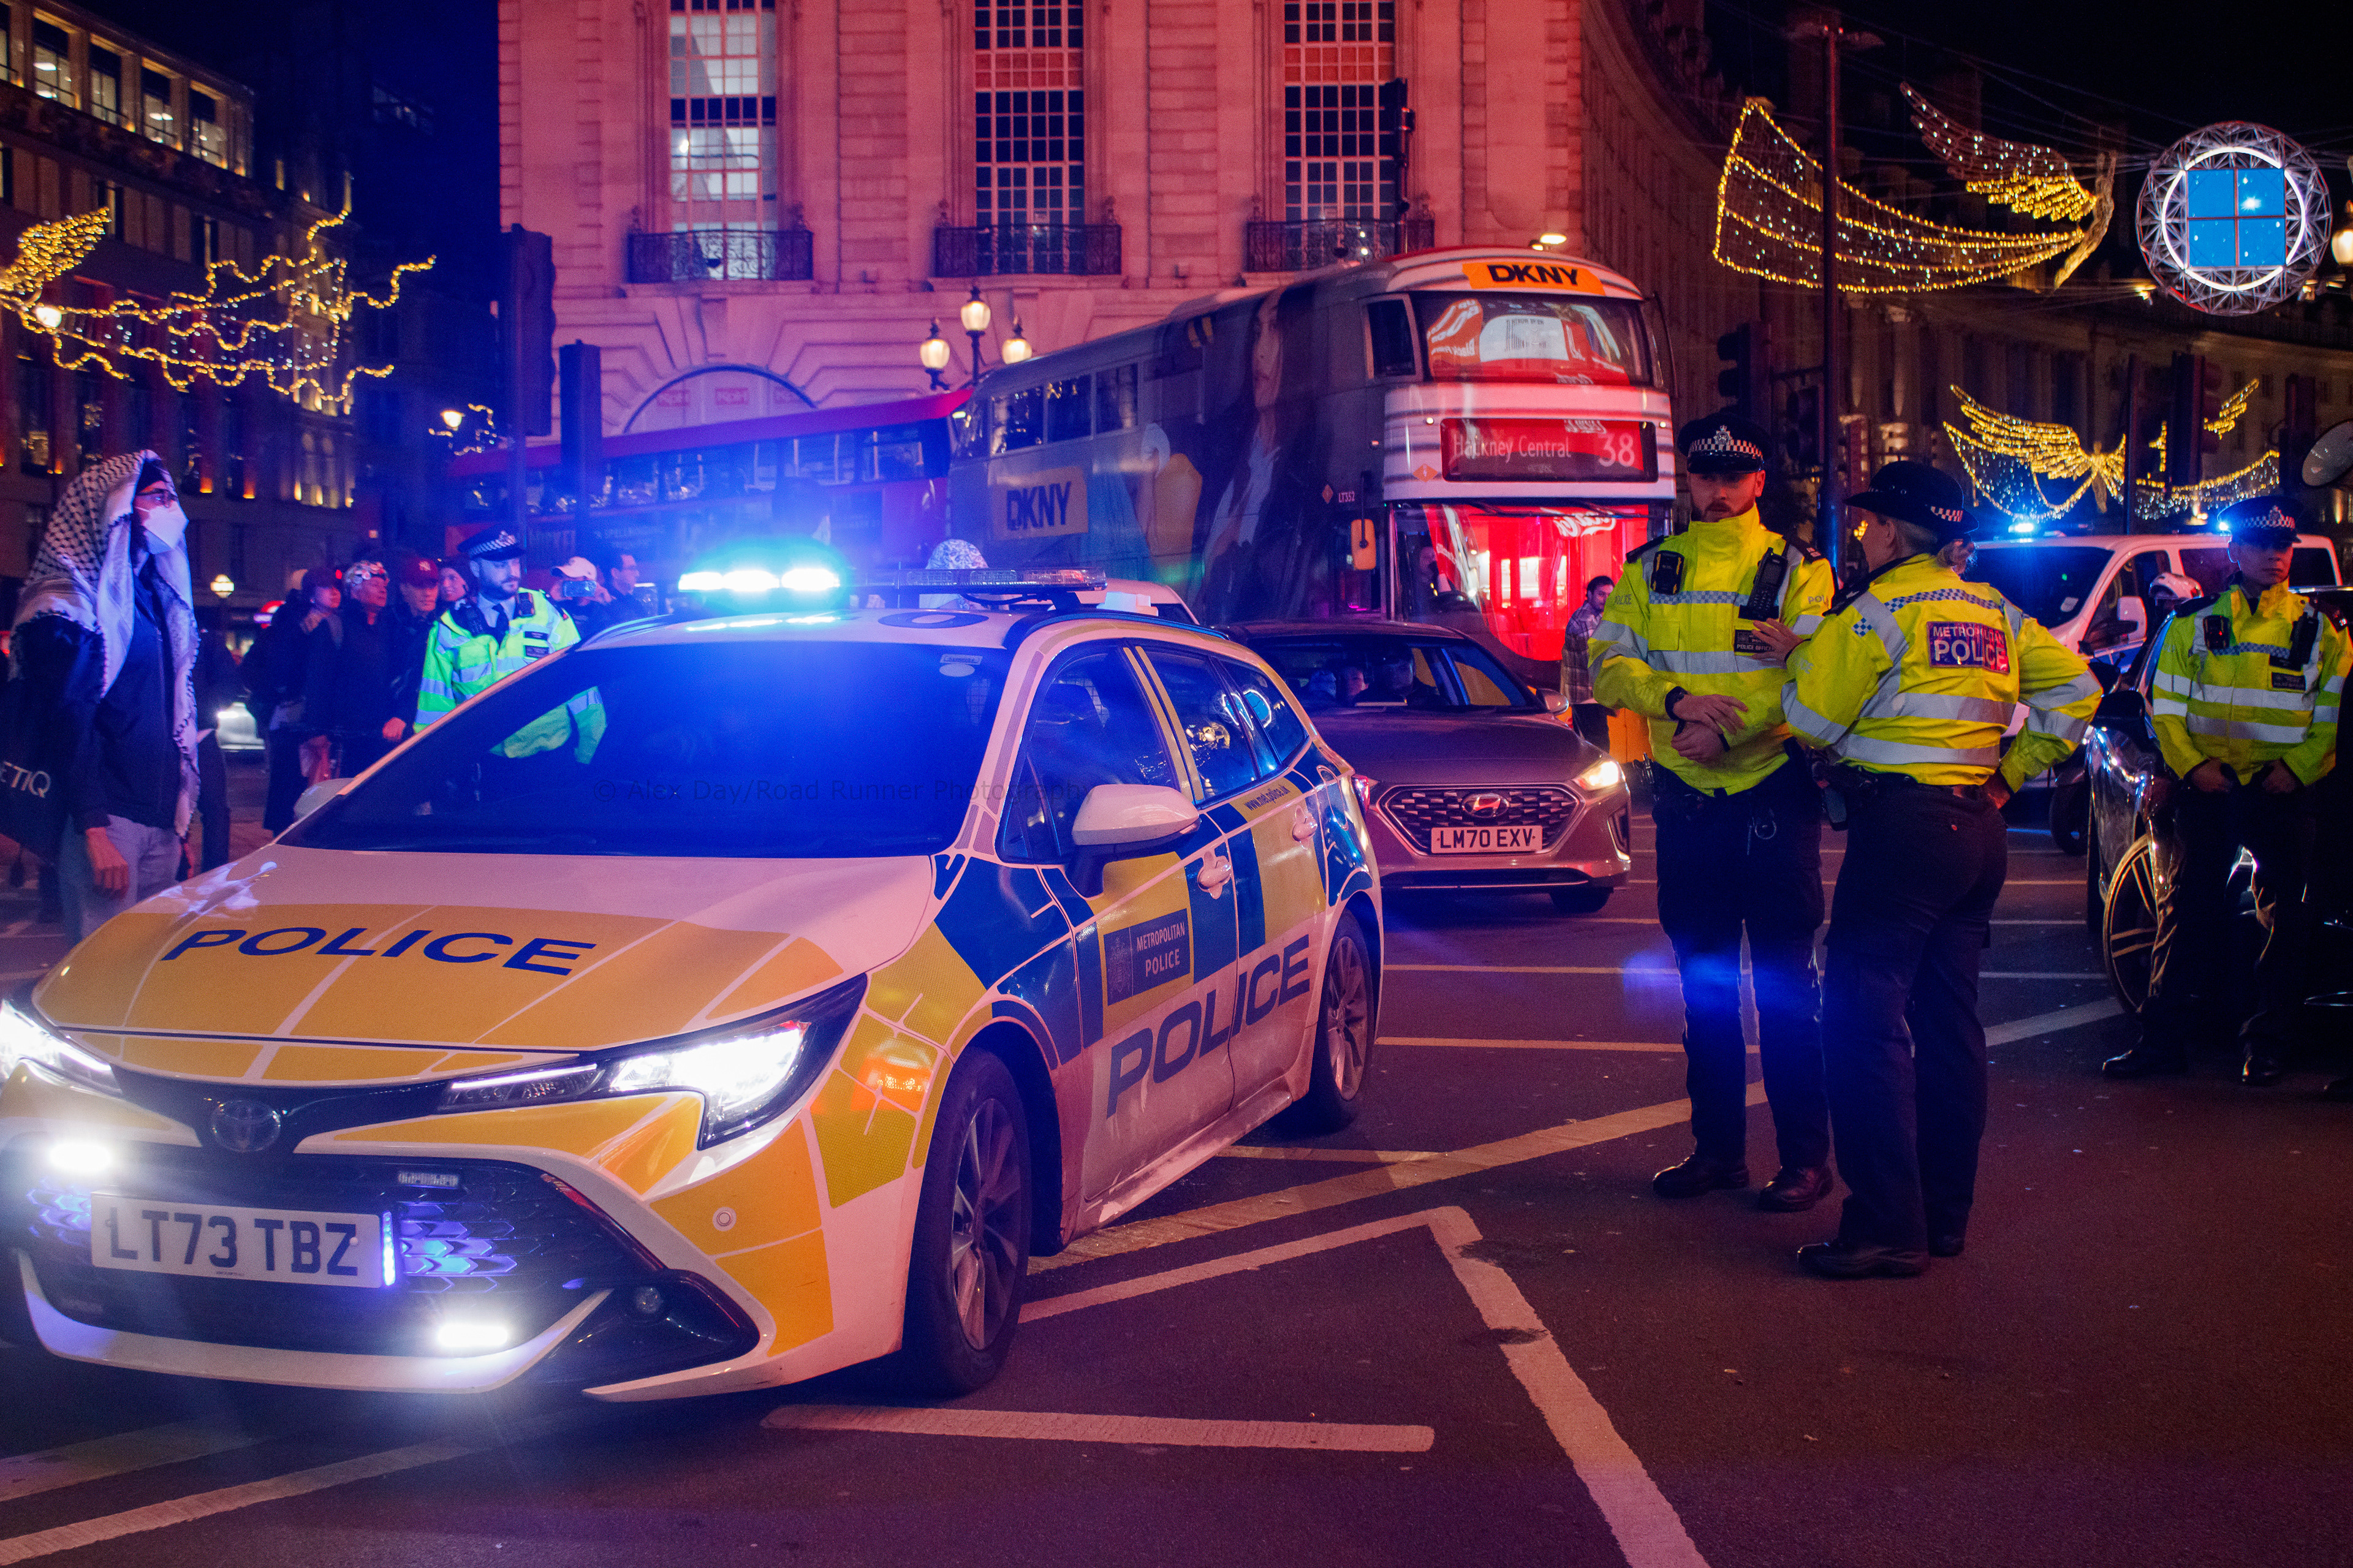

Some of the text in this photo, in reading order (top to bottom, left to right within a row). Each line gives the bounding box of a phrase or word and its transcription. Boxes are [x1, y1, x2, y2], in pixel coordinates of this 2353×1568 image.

[1487, 264, 1578, 286] DKNY
[1518, 434, 1571, 458] Central
[1597, 431, 1635, 468] 38
[1006, 481, 1072, 531] DKNY
[1934, 639, 2007, 670] POLCE
[1440, 828, 1533, 849] LM70 EXV
[160, 926, 597, 977] POLICE
[1137, 922, 1185, 952] METROPOLITAN
[1145, 949, 1180, 977] POLICE
[1106, 933, 1311, 1121] POLICE
[109, 1206, 358, 1277] LT73 TBZ
